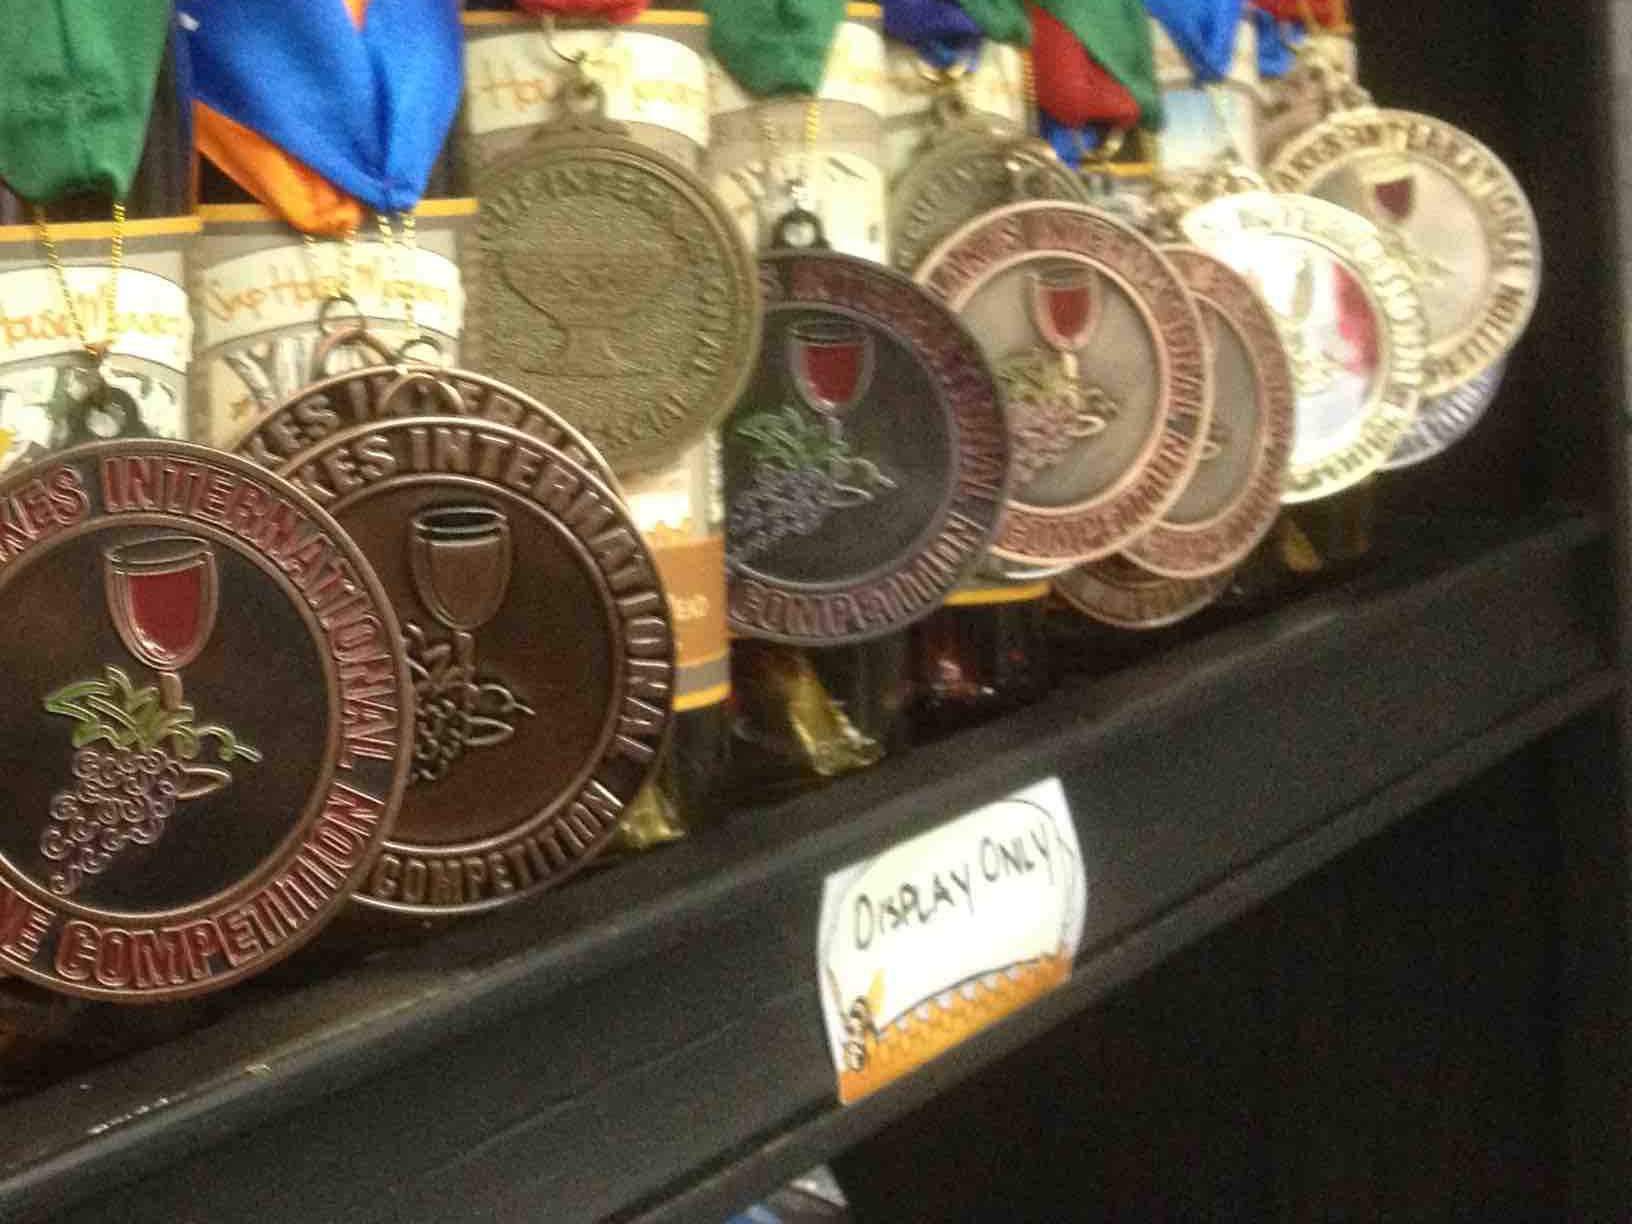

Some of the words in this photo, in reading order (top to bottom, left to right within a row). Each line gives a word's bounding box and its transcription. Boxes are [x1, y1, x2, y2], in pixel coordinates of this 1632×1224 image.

[102, 454, 401, 770] INTERNATIONAL
[410, 426, 669, 762] INTERNATIONAL
[55, 780, 385, 989] COMPETITION
[371, 778, 624, 905] COMPETITION
[979, 823, 1056, 885] ONLY
